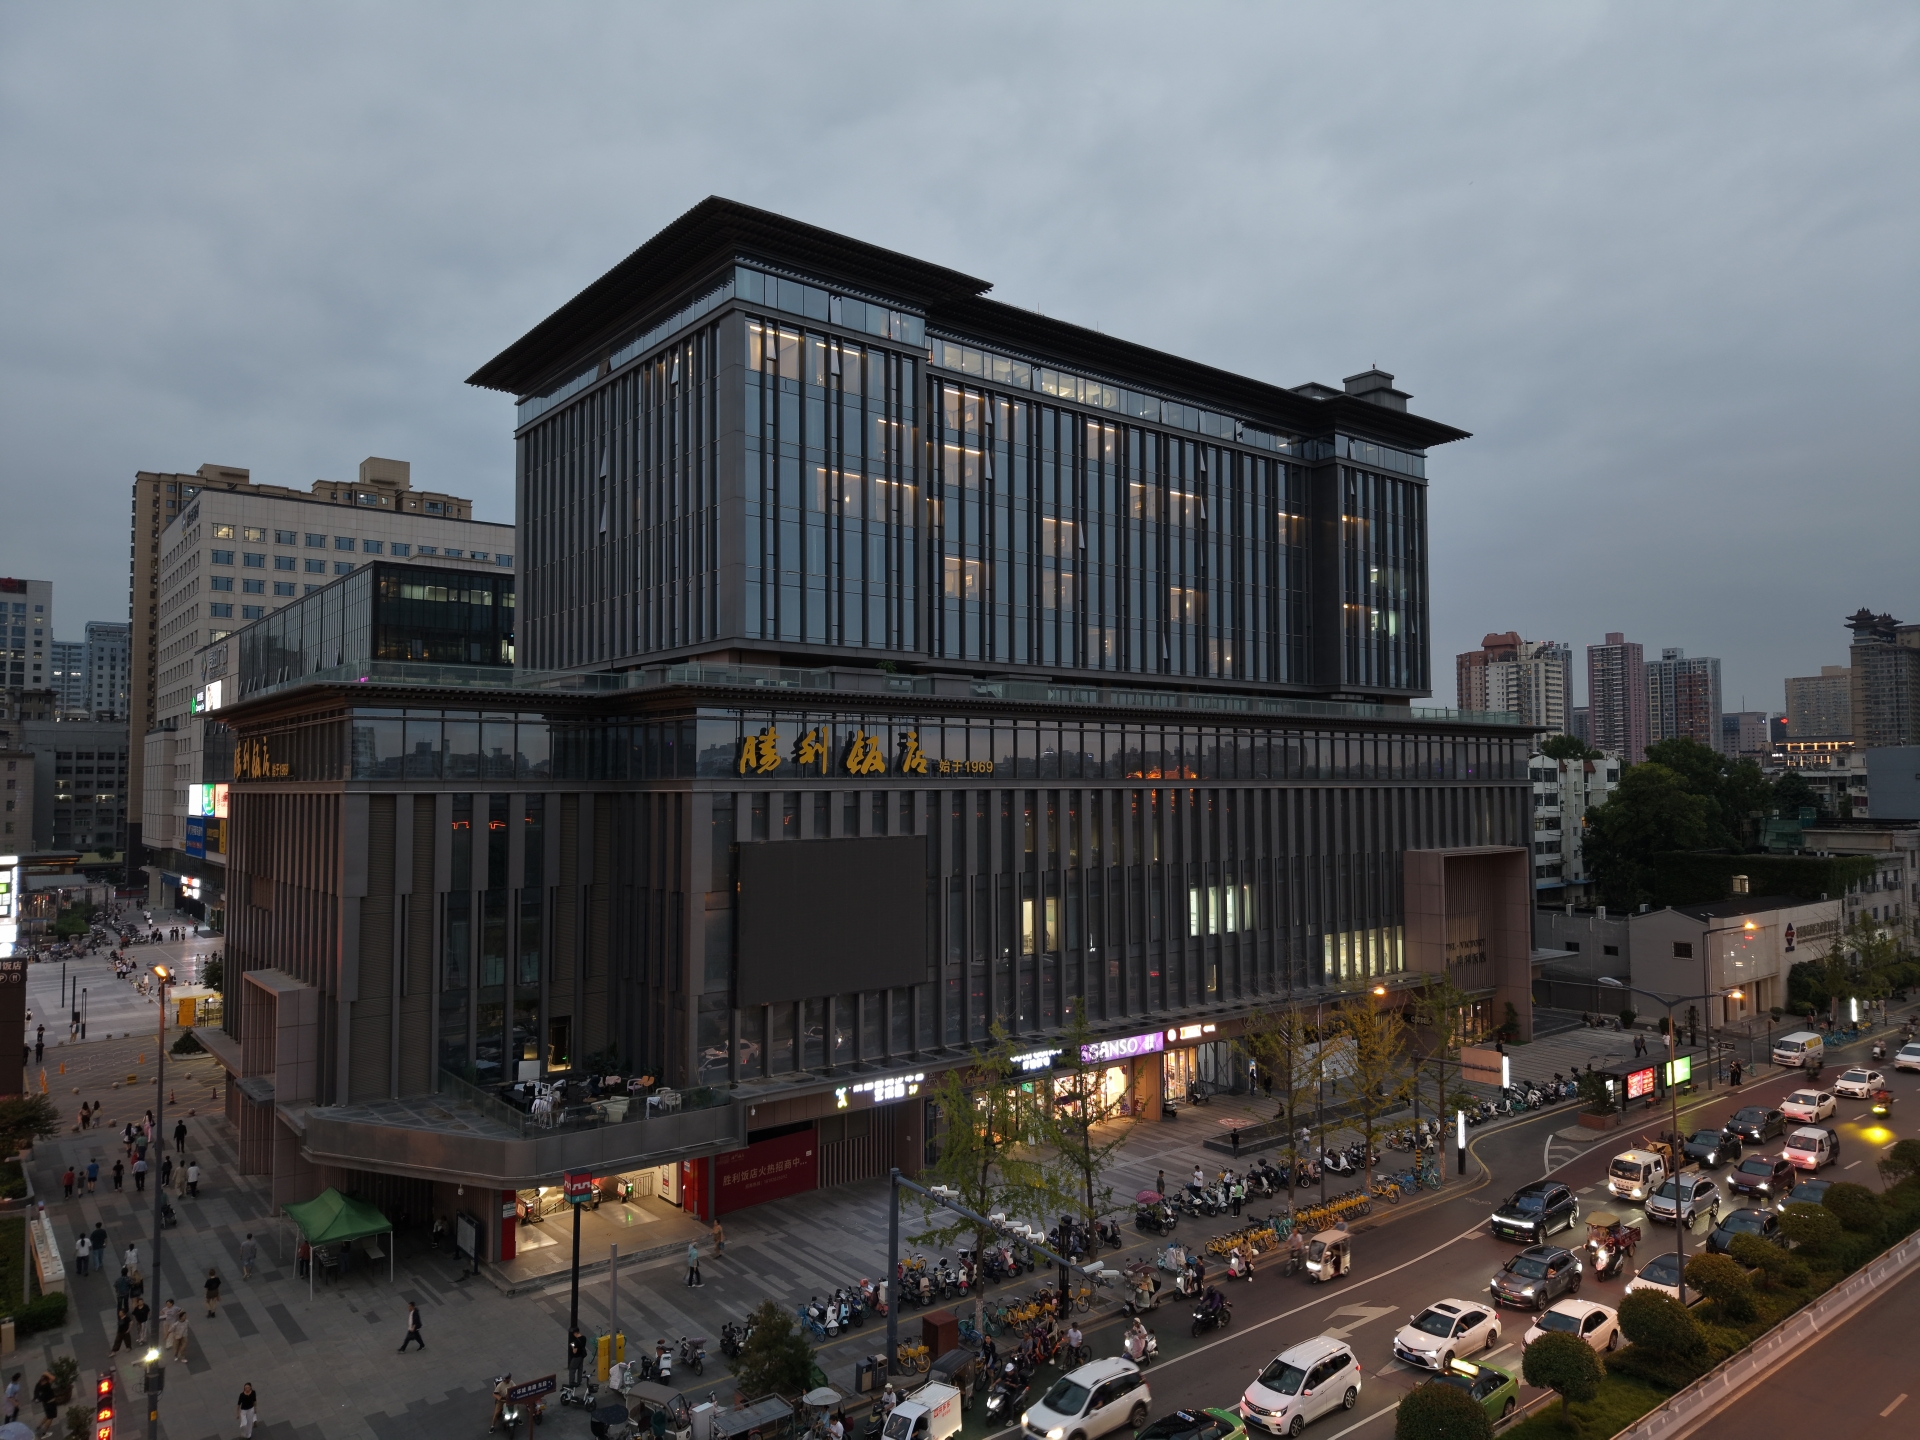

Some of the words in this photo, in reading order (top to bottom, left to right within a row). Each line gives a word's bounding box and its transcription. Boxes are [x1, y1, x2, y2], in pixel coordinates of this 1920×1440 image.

[939, 759, 994, 773] 始于1969
[0, 961, 22, 971] 饭店
[1089, 1038, 1138, 1060] GANSO
